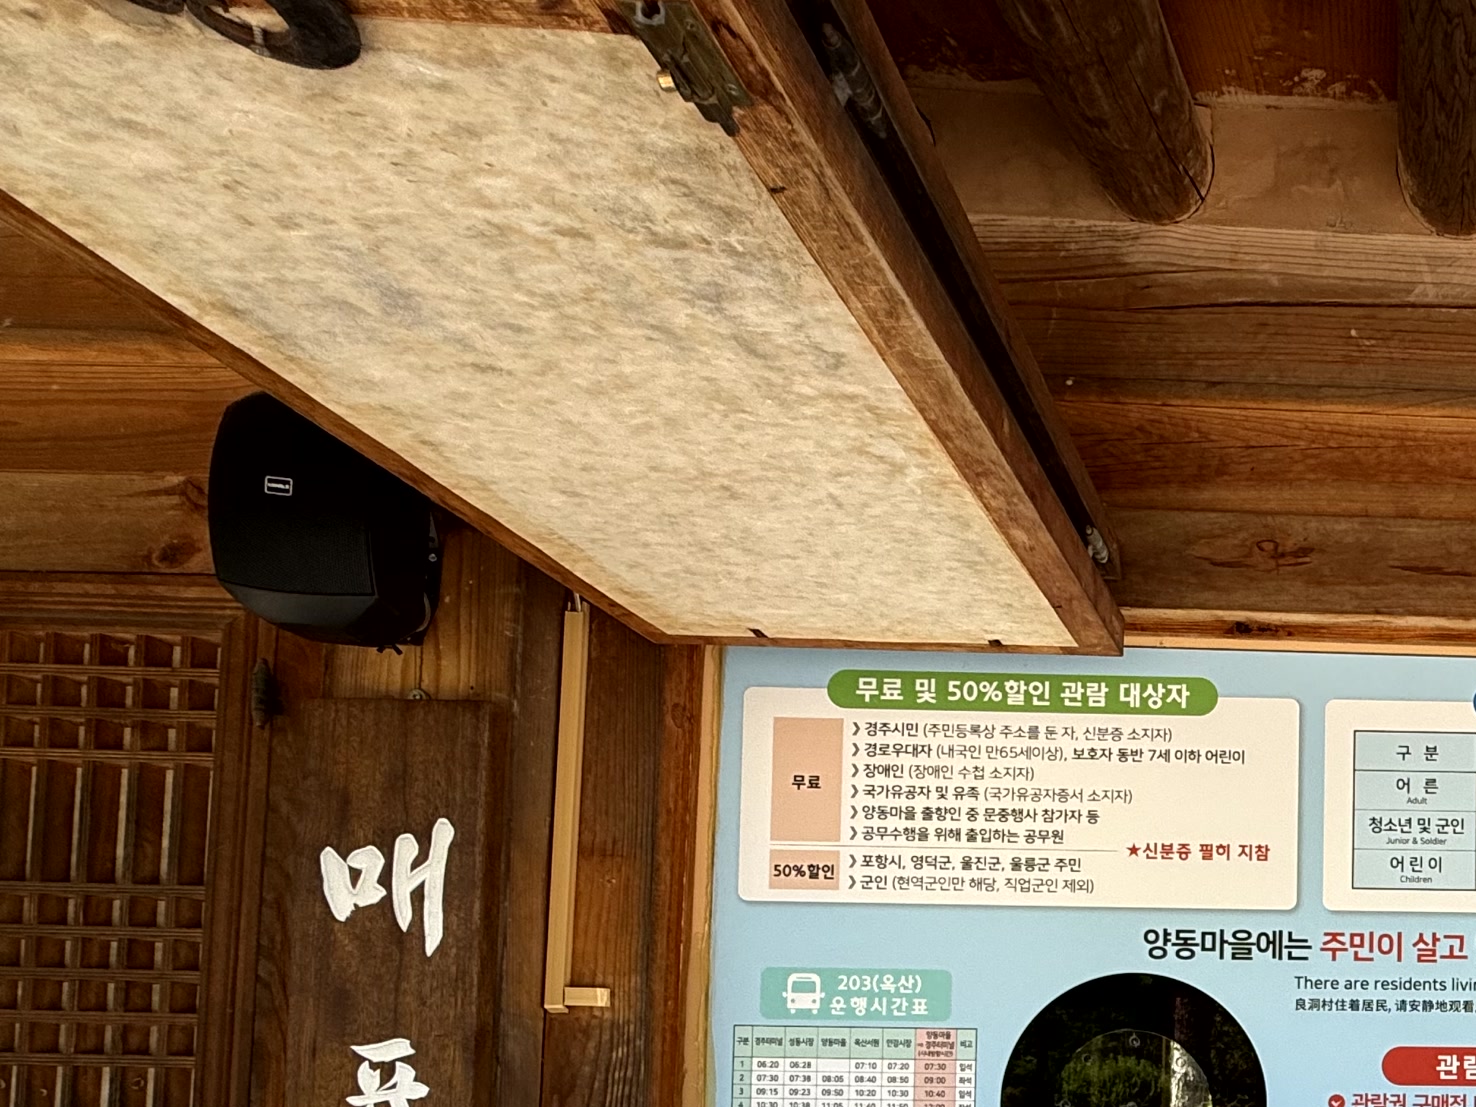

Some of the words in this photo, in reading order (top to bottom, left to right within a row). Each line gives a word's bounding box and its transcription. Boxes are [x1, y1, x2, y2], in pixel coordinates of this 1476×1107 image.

[855, 677, 904, 703] 무료
[914, 677, 937, 704] 및
[948, 679, 1049, 705] 50%할인
[1059, 681, 1109, 707] 관람
[1119, 683, 1189, 709] 대상자
[864, 721, 919, 738] 경주시민
[922, 722, 996, 739] (주민등록상
[998, 724, 1040, 740] 주소를
[1043, 725, 1058, 740] 둔
[1060, 725, 1078, 741] 자,
[1082, 726, 1124, 742] 신분증
[1126, 727, 1172, 743] 소지자)
[791, 774, 821, 791] 무료
[1368, 816, 1412, 834] 청소년
[1416, 816, 1431, 834] 및
[1434, 817, 1464, 835] 군인
[1142, 842, 1192, 861] 신분증
[1198, 843, 1230, 861] 필히
[1237, 843, 1270, 862] 지참
[772, 862, 834, 880] 50%할인
[1389, 855, 1442, 873] 어린이
[1399, 874, 1433, 883] Children
[1144, 928, 1311, 960] 양동마을에는
[1320, 931, 1401, 961] 주민이
[1413, 932, 1467, 962] 살고
[1293, 975, 1339, 990] There
[1343, 979, 1369, 990] are
[1373, 976, 1447, 991] residents
[829, 995, 928, 1017] 운행시간표
